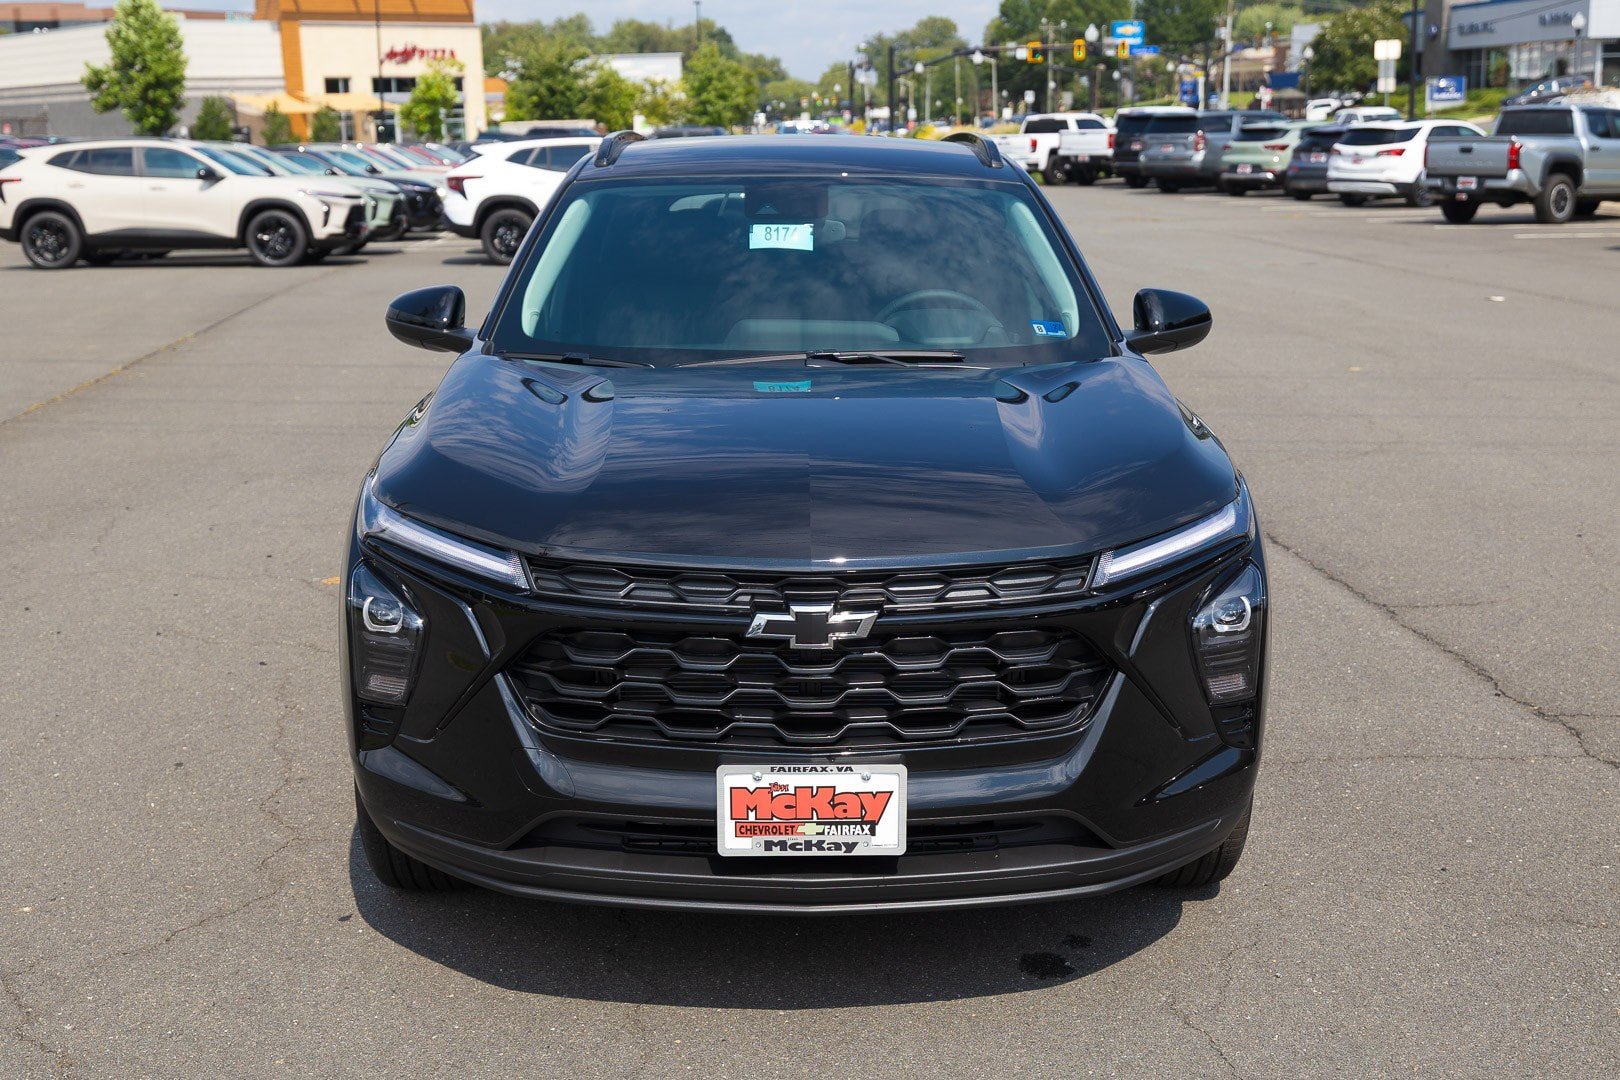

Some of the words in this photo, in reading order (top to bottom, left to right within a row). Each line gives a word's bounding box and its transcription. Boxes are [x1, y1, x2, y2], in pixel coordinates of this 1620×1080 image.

[730, 786, 893, 825] McKay
[738, 825, 796, 836] CHEVROLET
[824, 824, 871, 836] FAIRFAX
[764, 839, 859, 854] McKay
